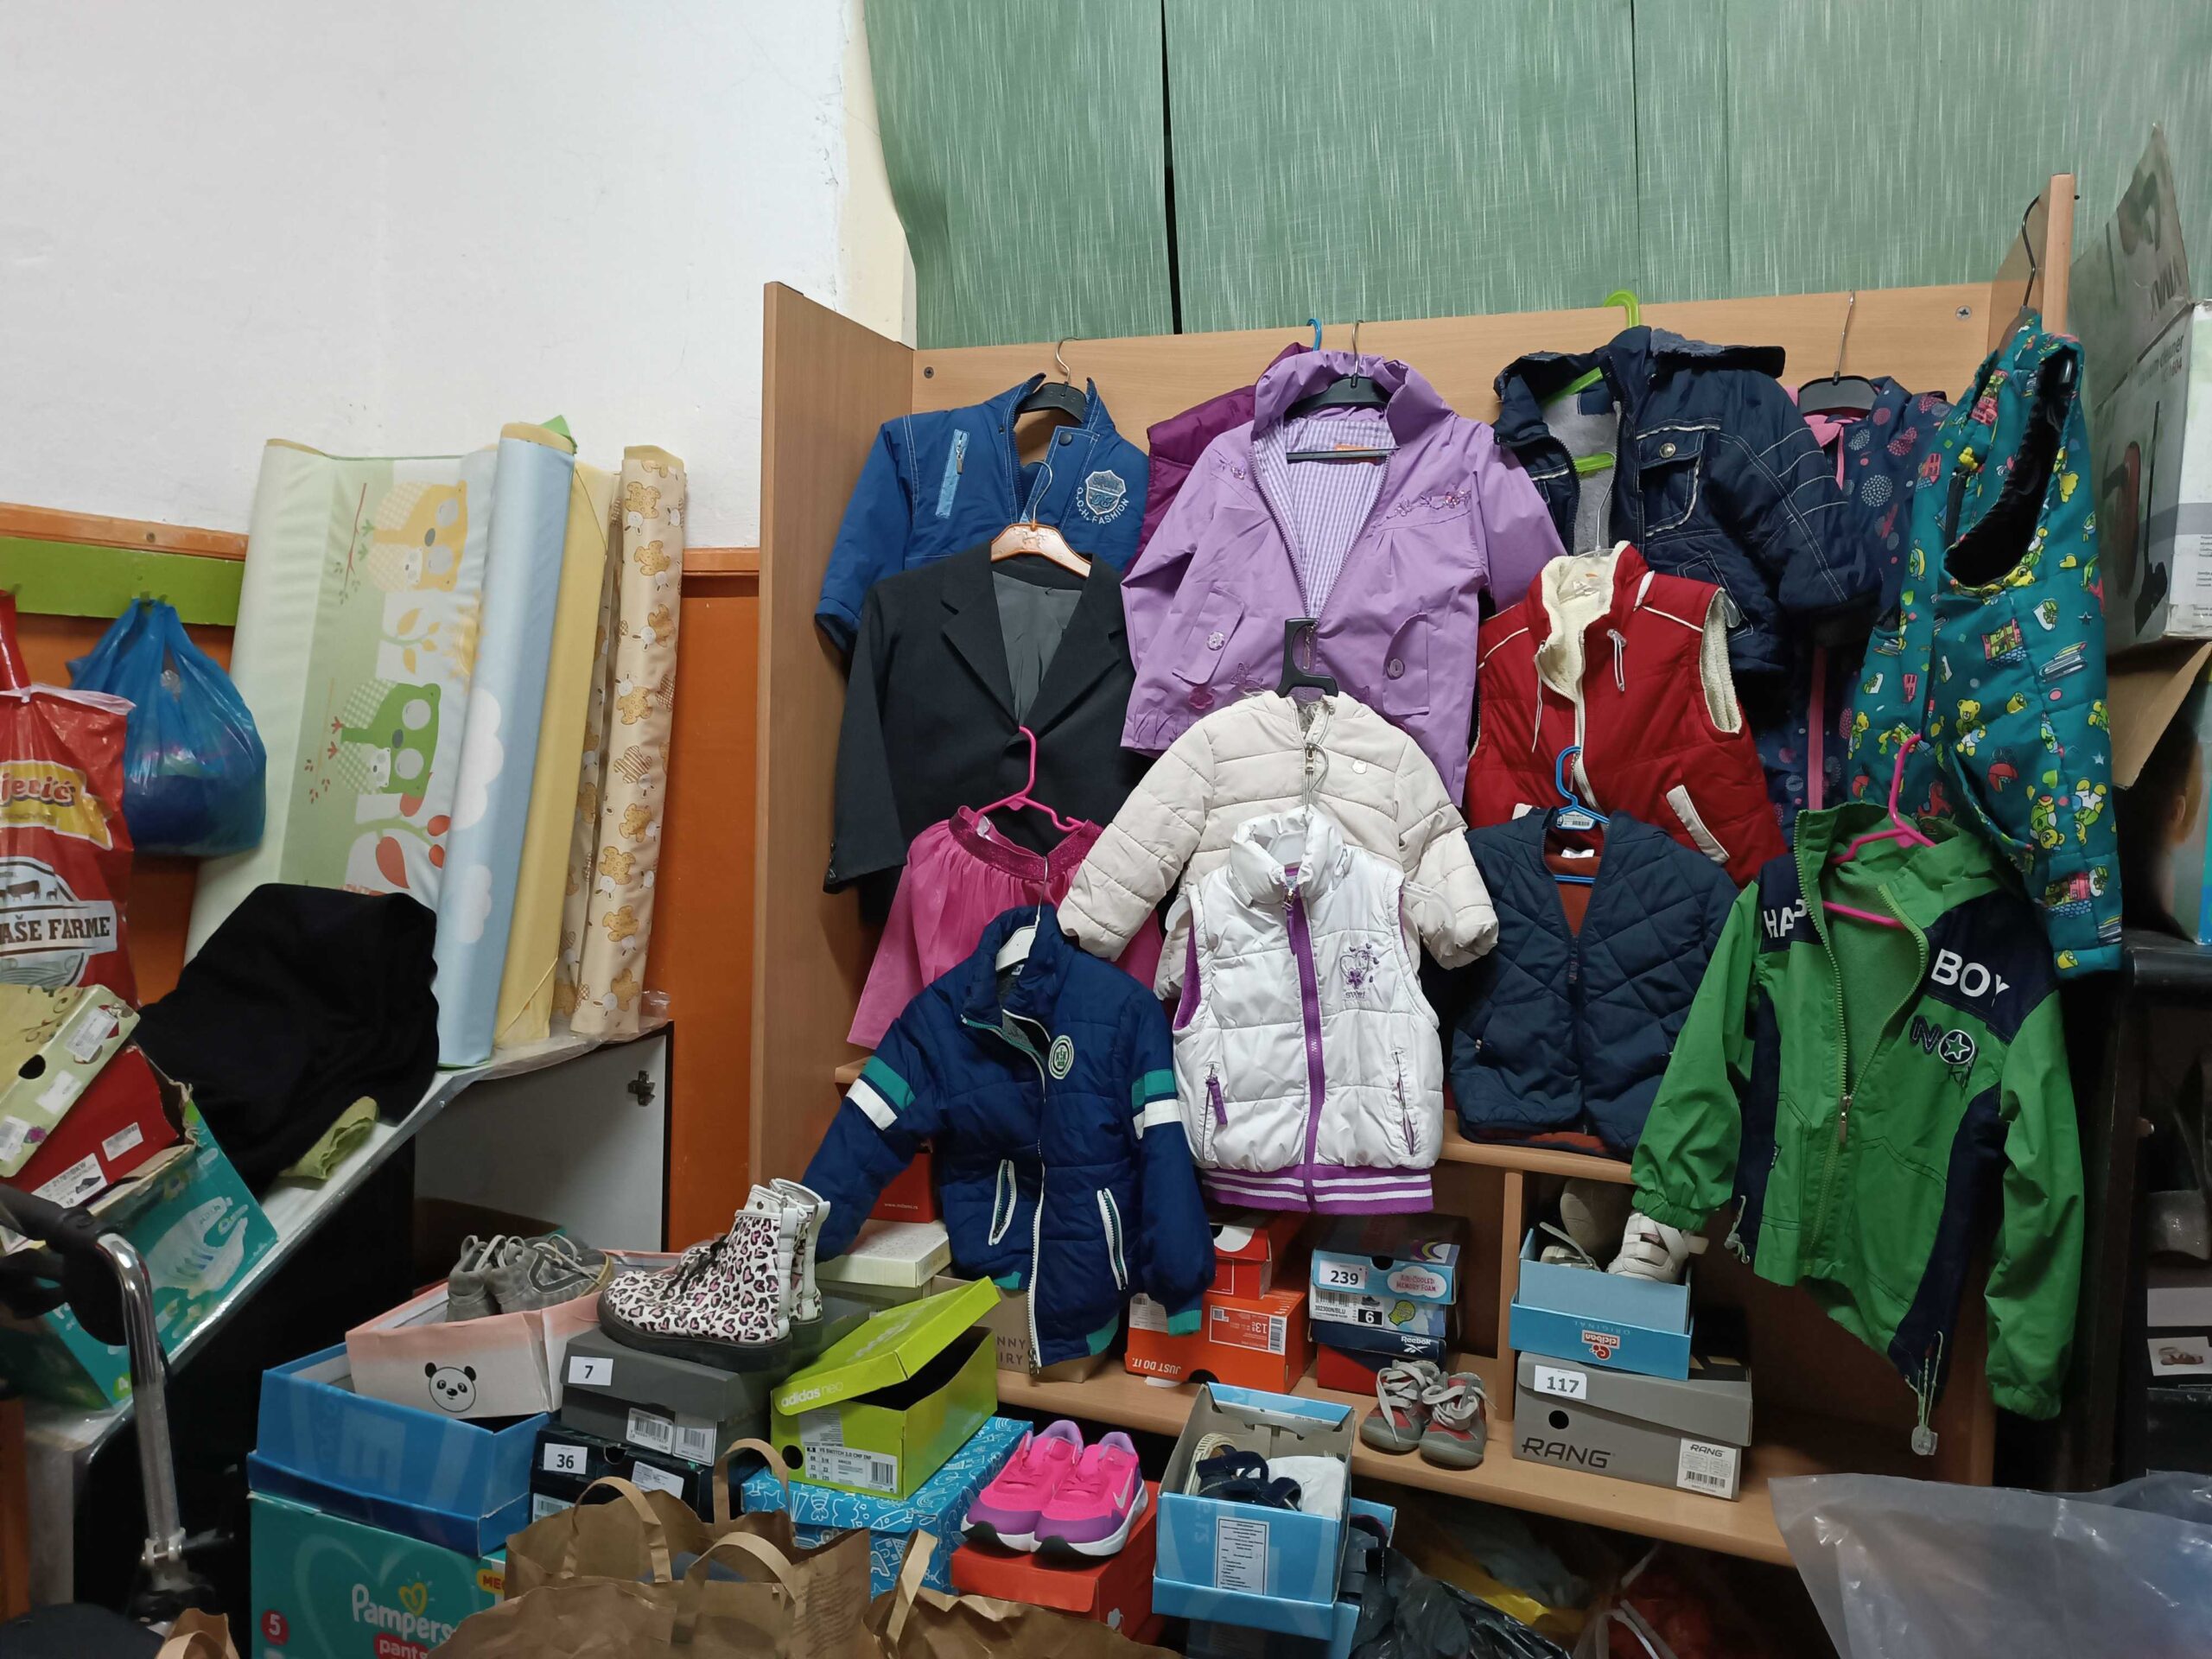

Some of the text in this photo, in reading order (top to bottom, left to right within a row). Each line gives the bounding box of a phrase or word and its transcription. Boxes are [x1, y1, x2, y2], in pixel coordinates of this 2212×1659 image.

[1091, 498, 1129, 524] FASHION
[48, 916, 111, 940] FARME
[1930, 948, 2011, 1007] BOY
[1331, 1270, 1359, 1286] 239
[1421, 1283, 1437, 1293] FOAM
[1364, 1310, 1376, 1324] 6
[1573, 1319, 1631, 1336] ORIGINAL
[1400, 1335, 1432, 1346] Reebok
[1585, 1332, 1618, 1346] ciciban
[584, 1364, 594, 1379] 7
[1143, 1359, 1156, 1370] DO
[1158, 1362, 1182, 1375] JUST
[1546, 1376, 1580, 1394] 117
[780, 1381, 844, 1408] adidas neo
[1521, 1437, 1611, 1470] RANG
[1689, 1444, 1726, 1458] RANG
[556, 1453, 575, 1470] 36
[351, 1583, 459, 1644] Pampers
[268, 1613, 282, 1637] 5
